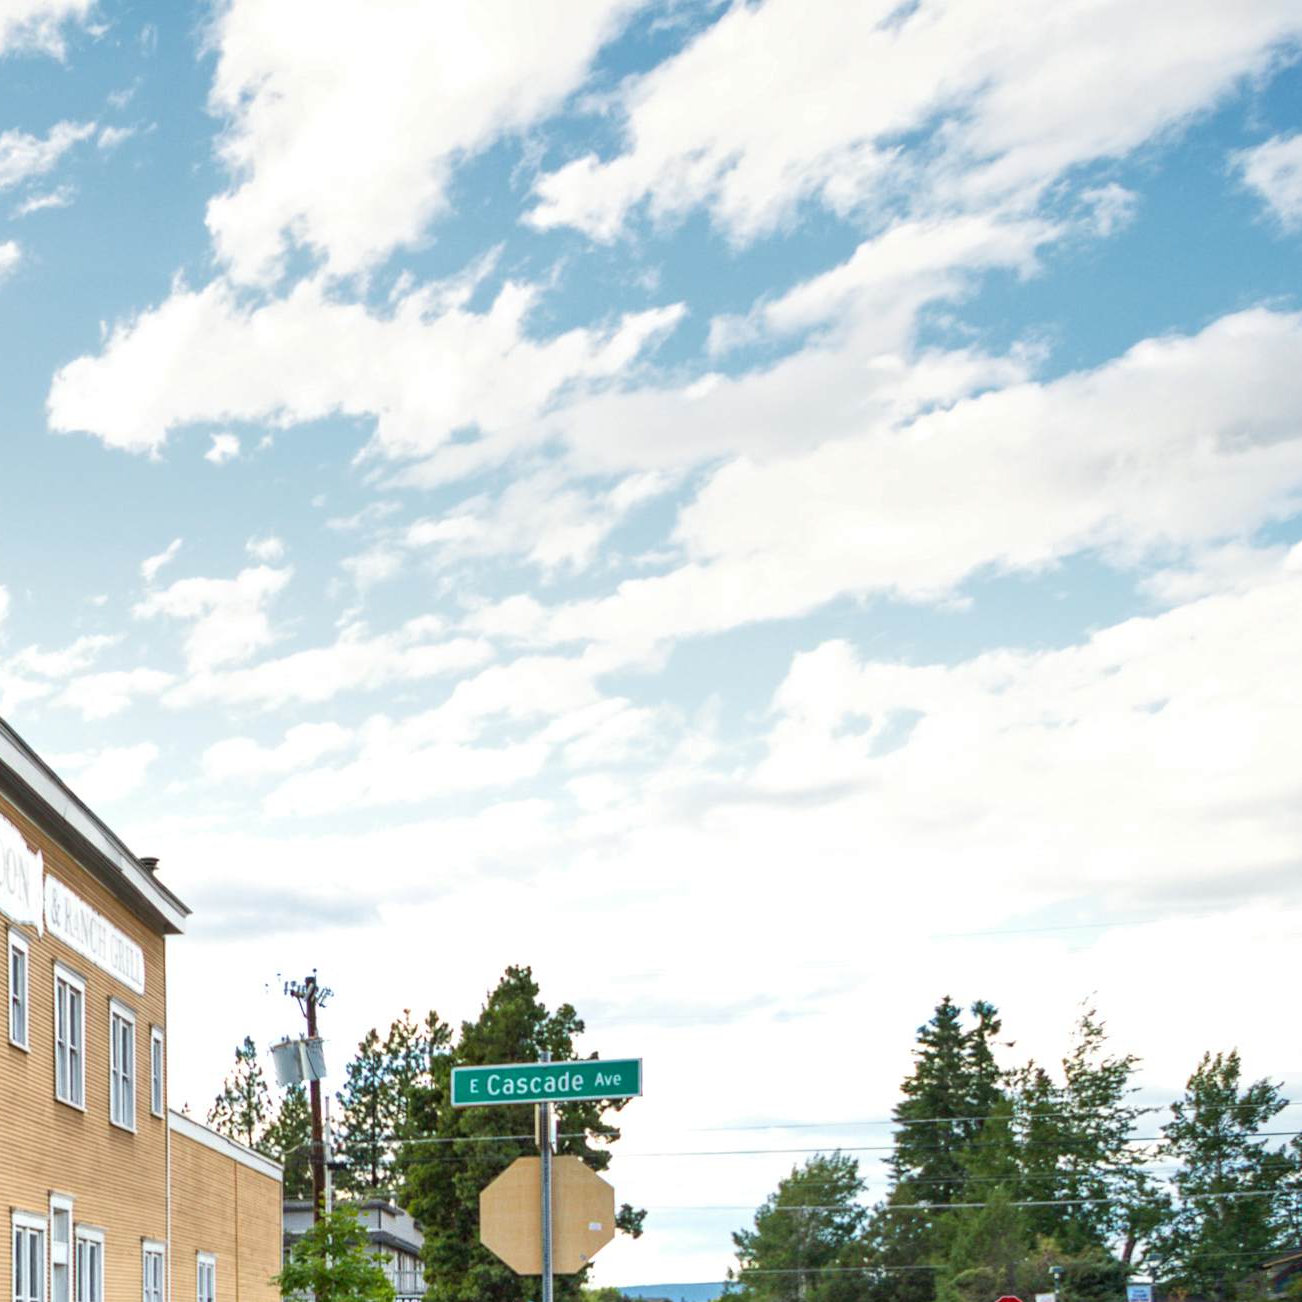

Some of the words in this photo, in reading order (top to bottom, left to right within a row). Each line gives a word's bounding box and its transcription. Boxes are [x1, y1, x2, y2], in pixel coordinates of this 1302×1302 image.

[470, 1078, 479, 1093] E
[487, 1071, 584, 1096] Cascade
[595, 1071, 623, 1087] Ave
